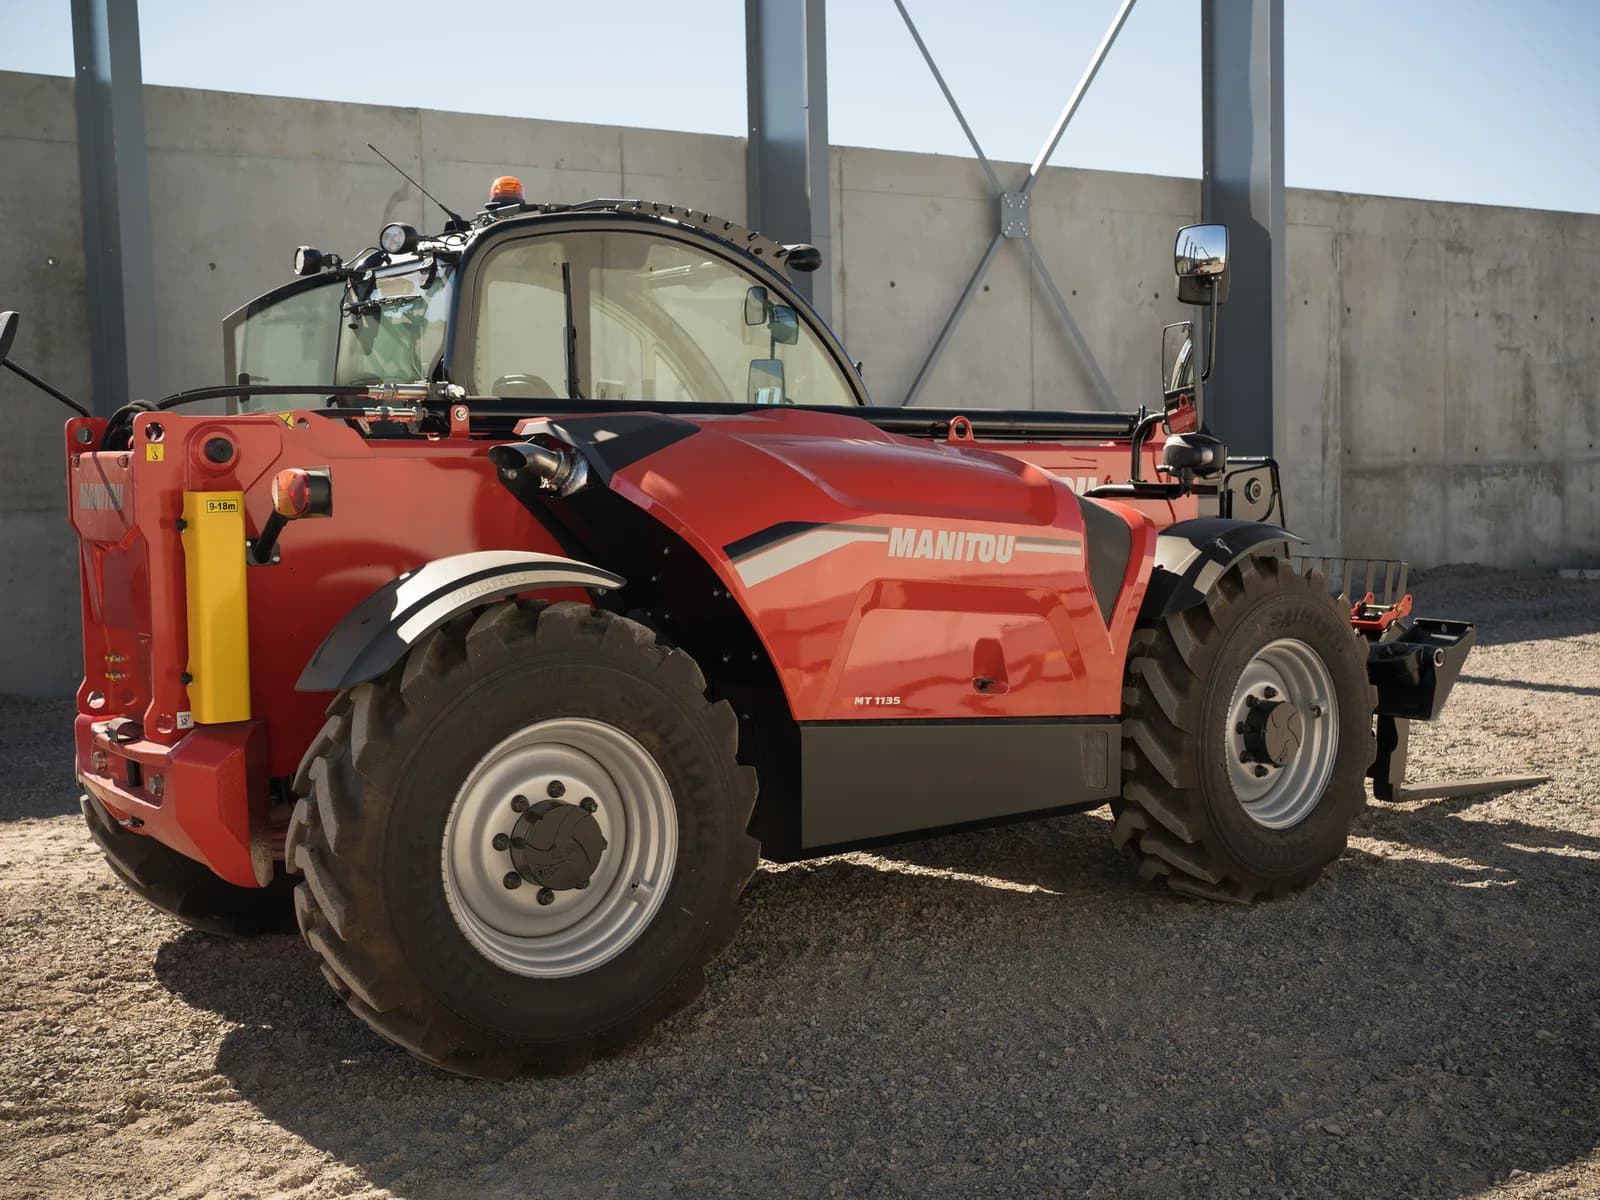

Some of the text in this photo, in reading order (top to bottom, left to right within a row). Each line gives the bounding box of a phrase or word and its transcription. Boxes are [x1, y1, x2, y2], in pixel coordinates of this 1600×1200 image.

[209, 501, 236, 511] 9-18m
[888, 527, 1015, 564] MANITOU
[854, 696, 901, 705] MT 1135
